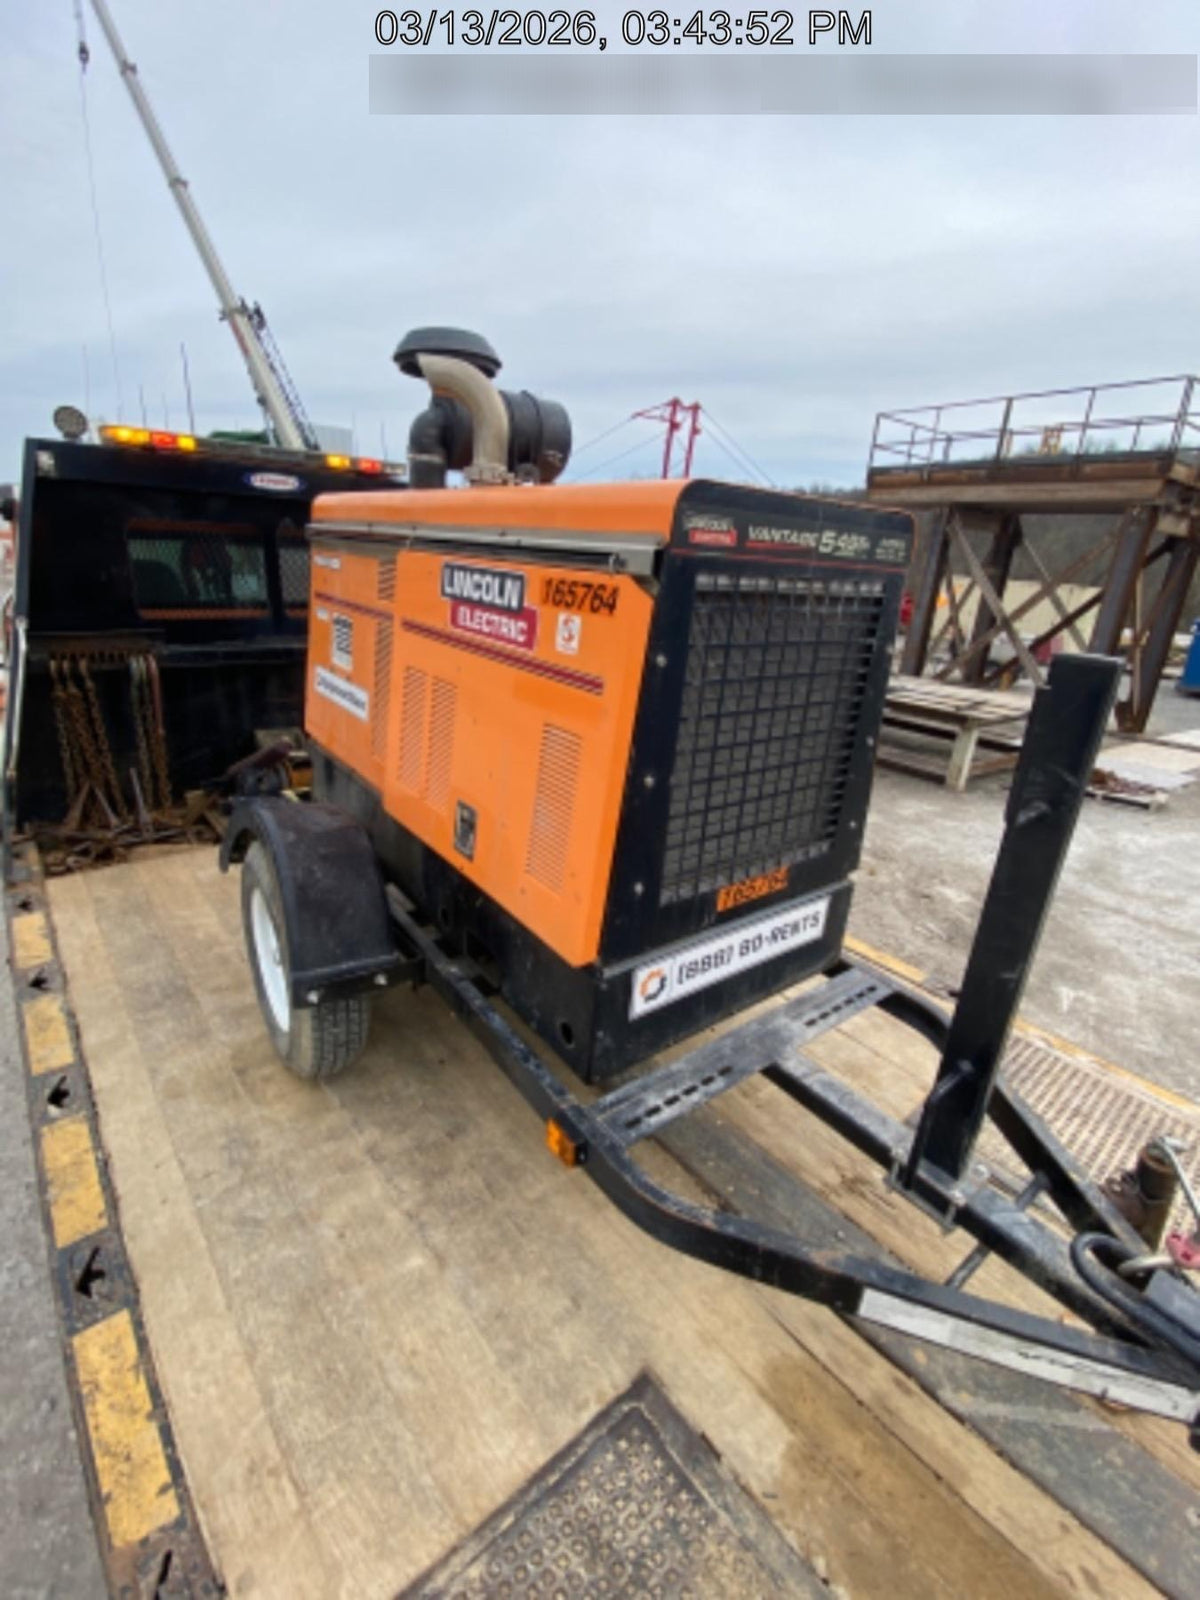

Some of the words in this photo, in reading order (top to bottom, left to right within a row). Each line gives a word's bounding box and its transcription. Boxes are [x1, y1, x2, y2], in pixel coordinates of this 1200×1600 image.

[443, 566, 522, 610] LINCOLN
[542, 577, 619, 615] 165764
[457, 605, 529, 643] ELECTRIC
